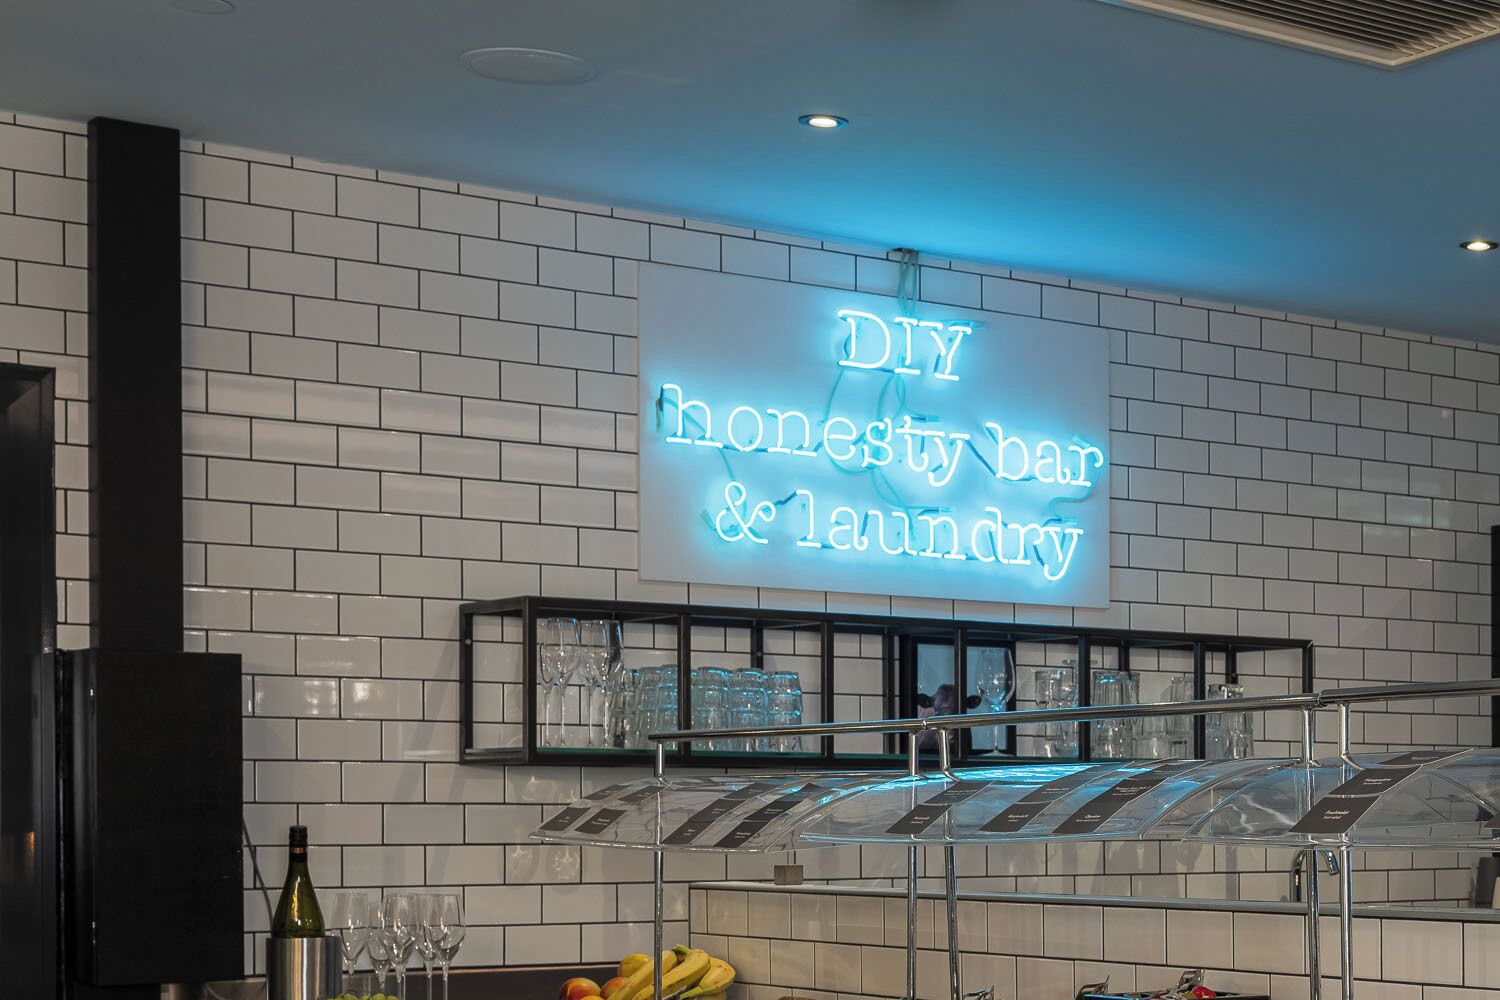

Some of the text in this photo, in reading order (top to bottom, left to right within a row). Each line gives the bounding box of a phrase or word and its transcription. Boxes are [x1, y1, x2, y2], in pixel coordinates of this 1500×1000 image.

[837, 309, 973, 382] DIY
[661, 382, 1104, 488] honesty bar
[715, 481, 1085, 582] & laundry
